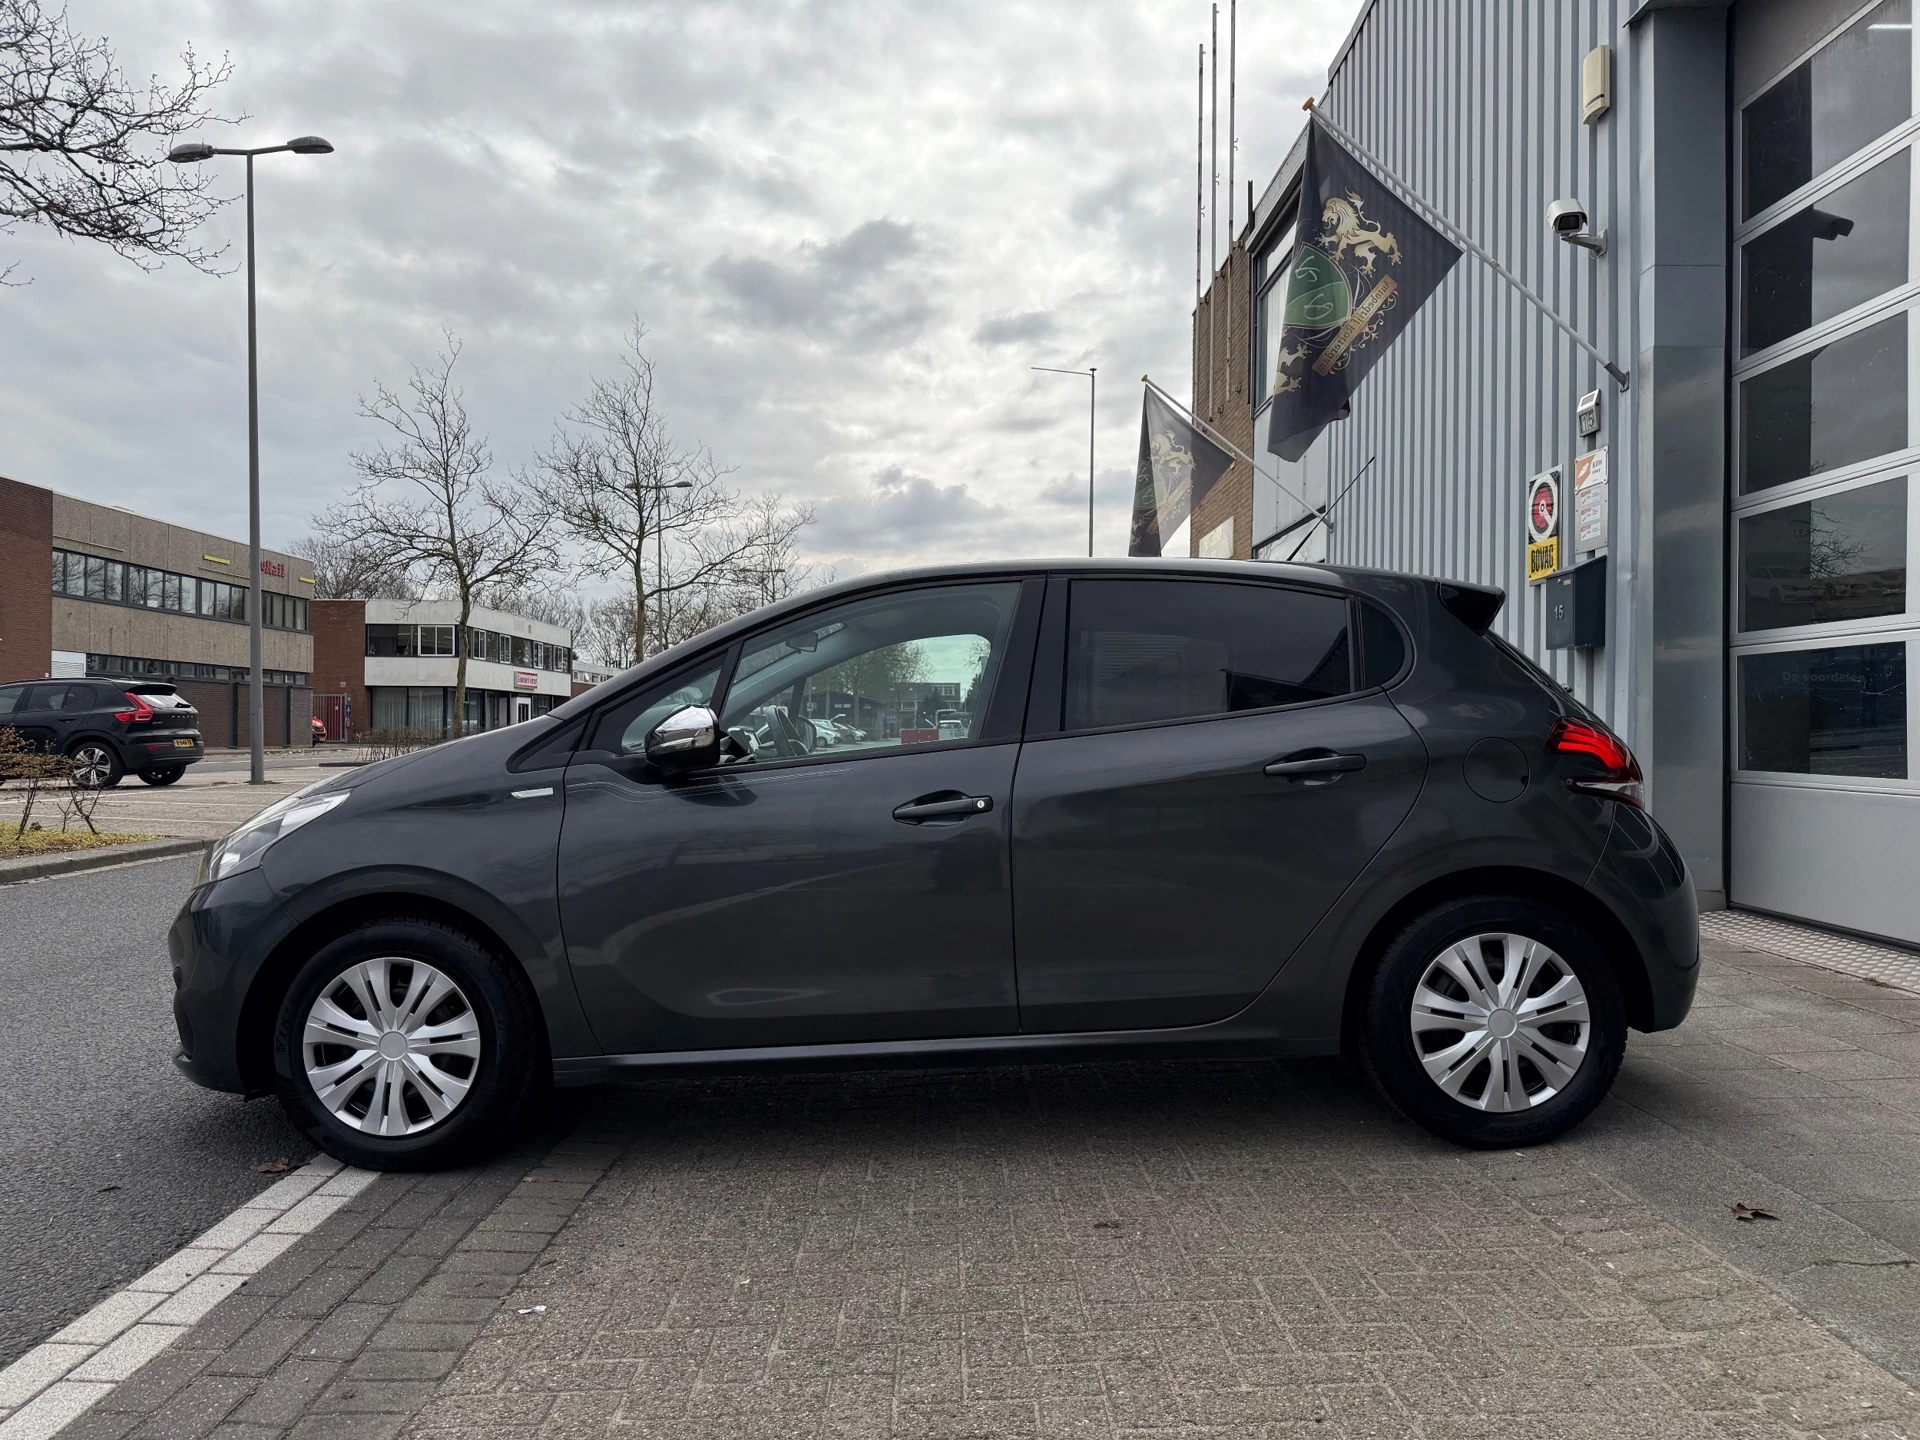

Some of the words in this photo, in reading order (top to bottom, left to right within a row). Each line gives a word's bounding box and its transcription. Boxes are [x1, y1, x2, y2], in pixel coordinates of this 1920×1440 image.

[1582, 412, 1594, 431] 15
[1531, 544, 1554, 574] BOVAG
[1553, 604, 1564, 621] 15
